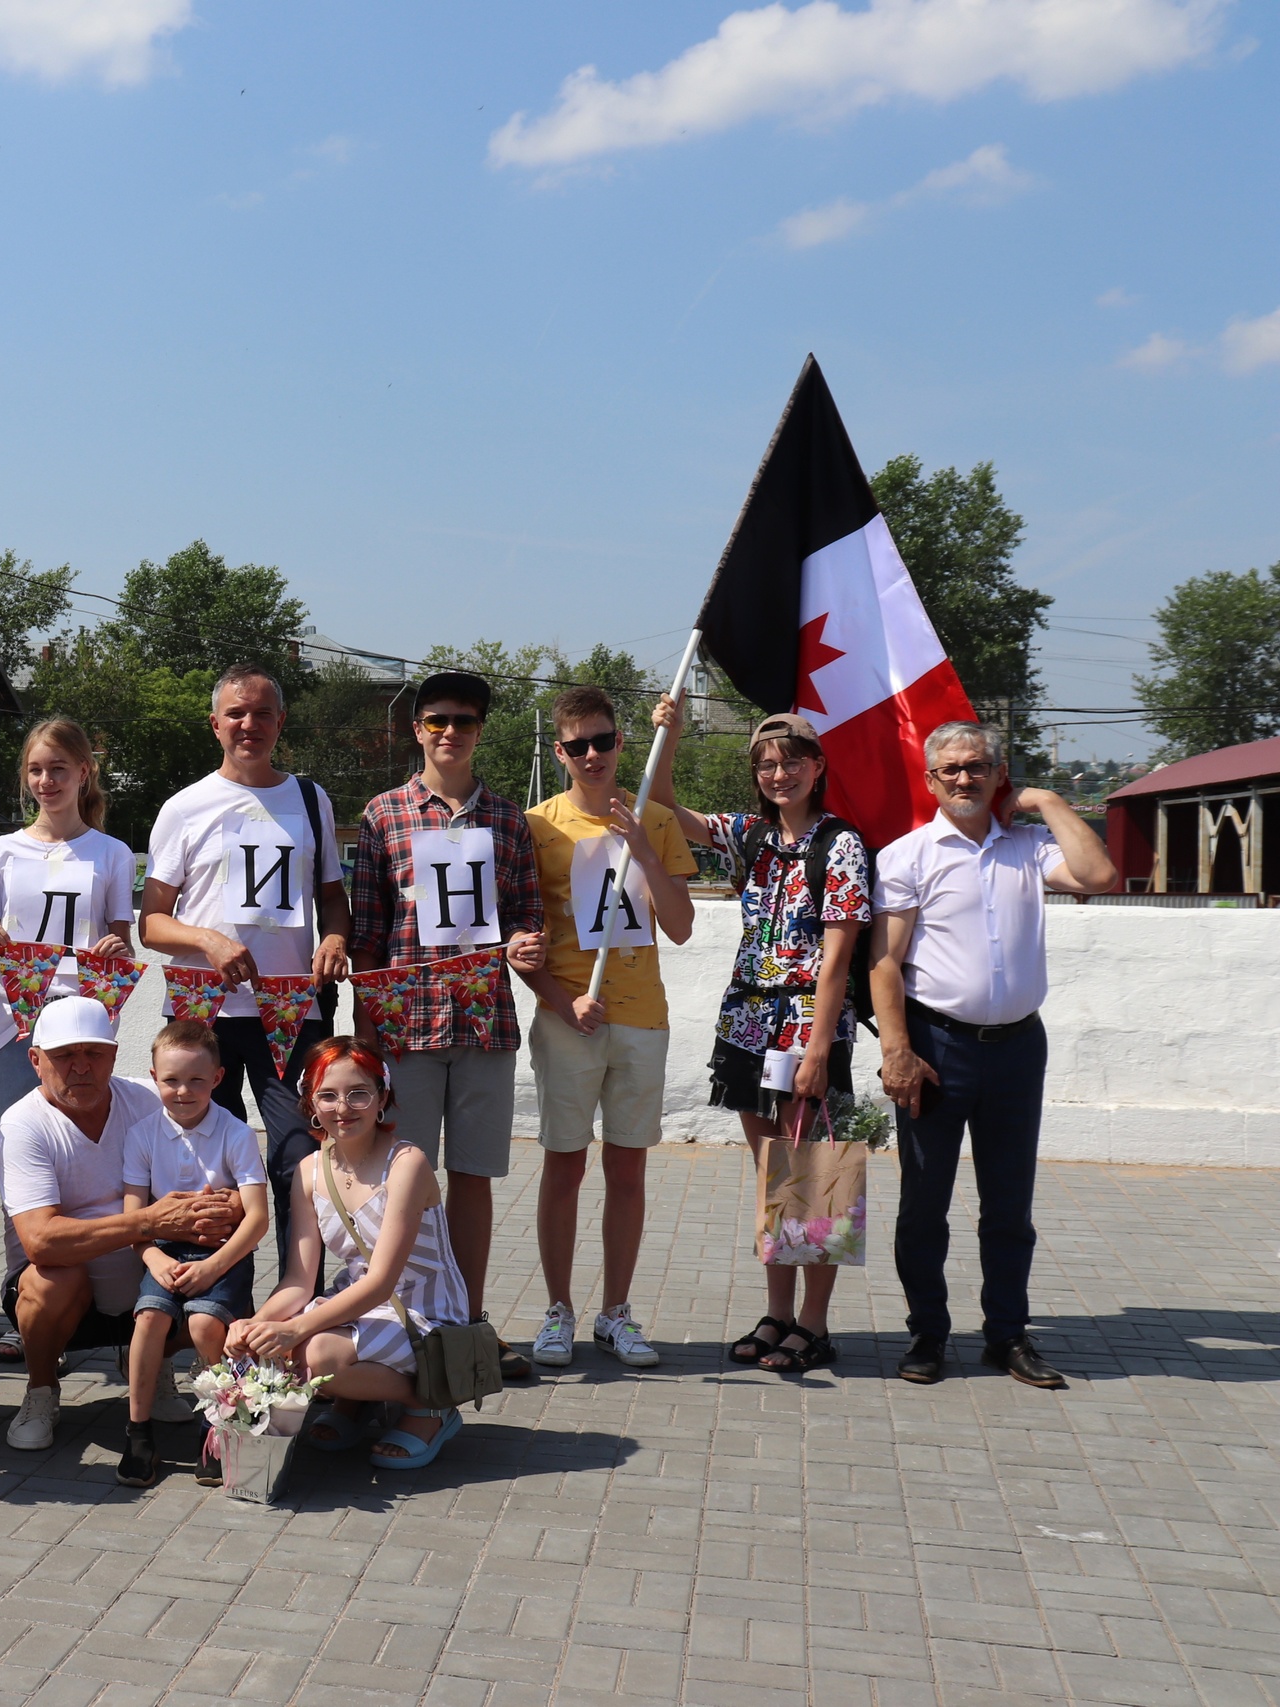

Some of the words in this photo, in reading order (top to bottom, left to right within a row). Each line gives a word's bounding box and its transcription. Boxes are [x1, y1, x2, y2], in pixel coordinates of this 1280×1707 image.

[239, 844, 295, 911] И
[430, 860, 490, 929] Н
[588, 867, 643, 934] А
[35, 890, 82, 957] Л
[231, 1487, 259, 1499] FLEURS
